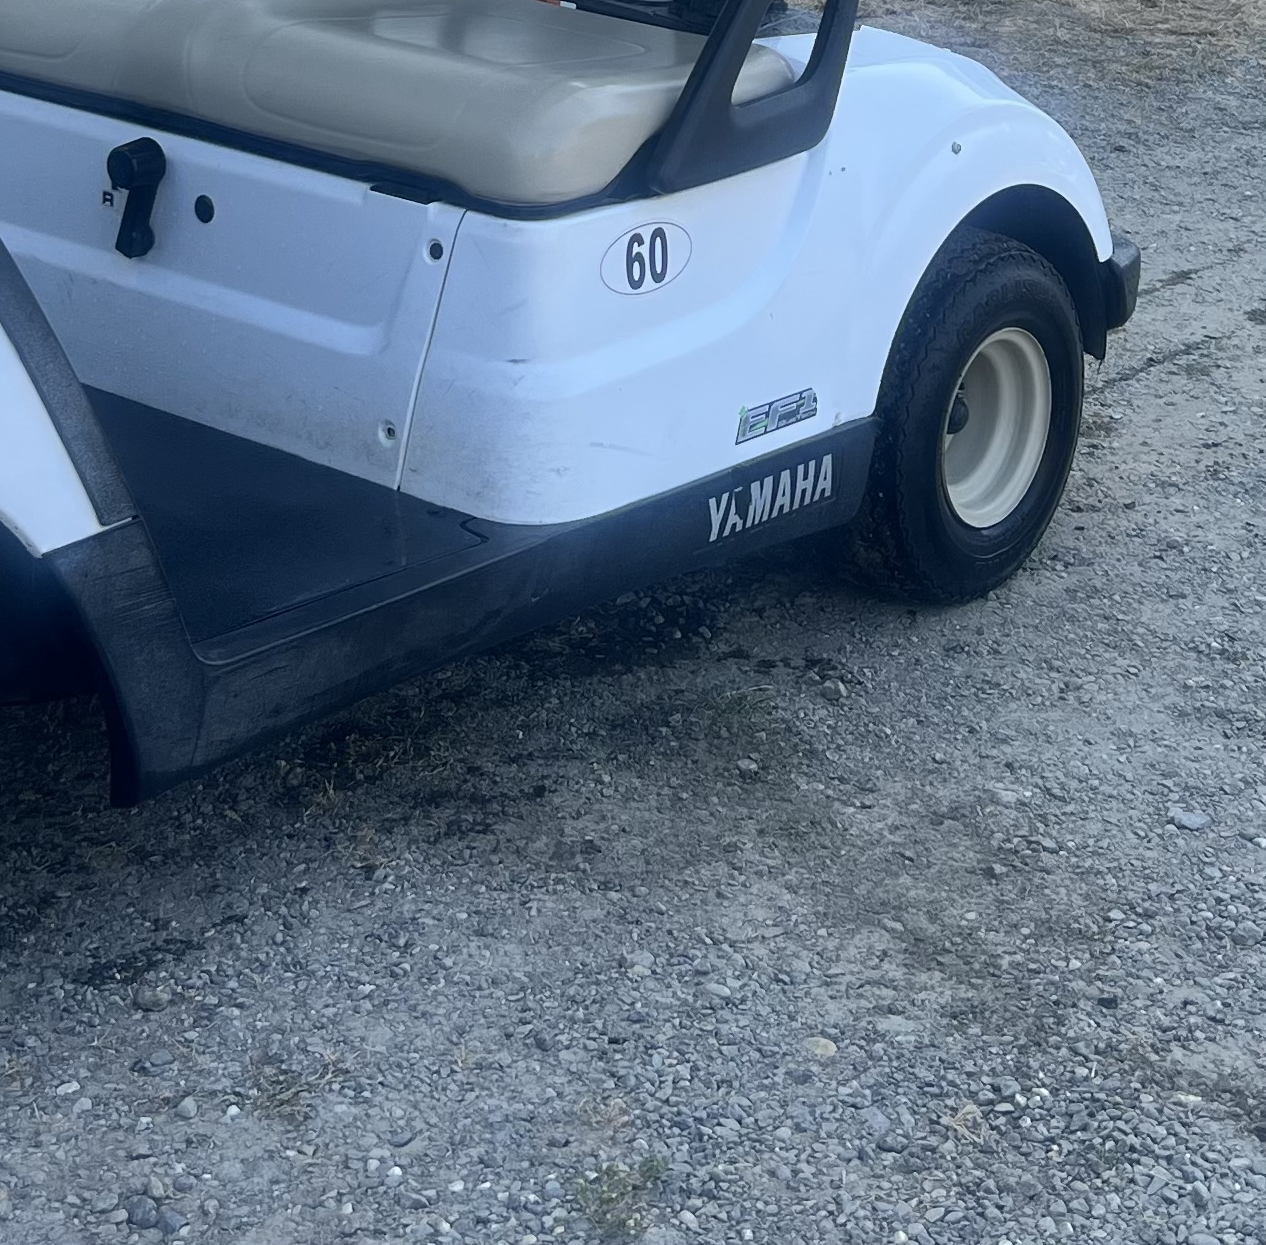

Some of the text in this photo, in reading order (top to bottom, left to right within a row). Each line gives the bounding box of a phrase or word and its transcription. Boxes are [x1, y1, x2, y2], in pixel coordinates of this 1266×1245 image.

[102, 190, 114, 206] R
[626, 226, 668, 290] 60
[708, 453, 833, 543] YAMAHA
